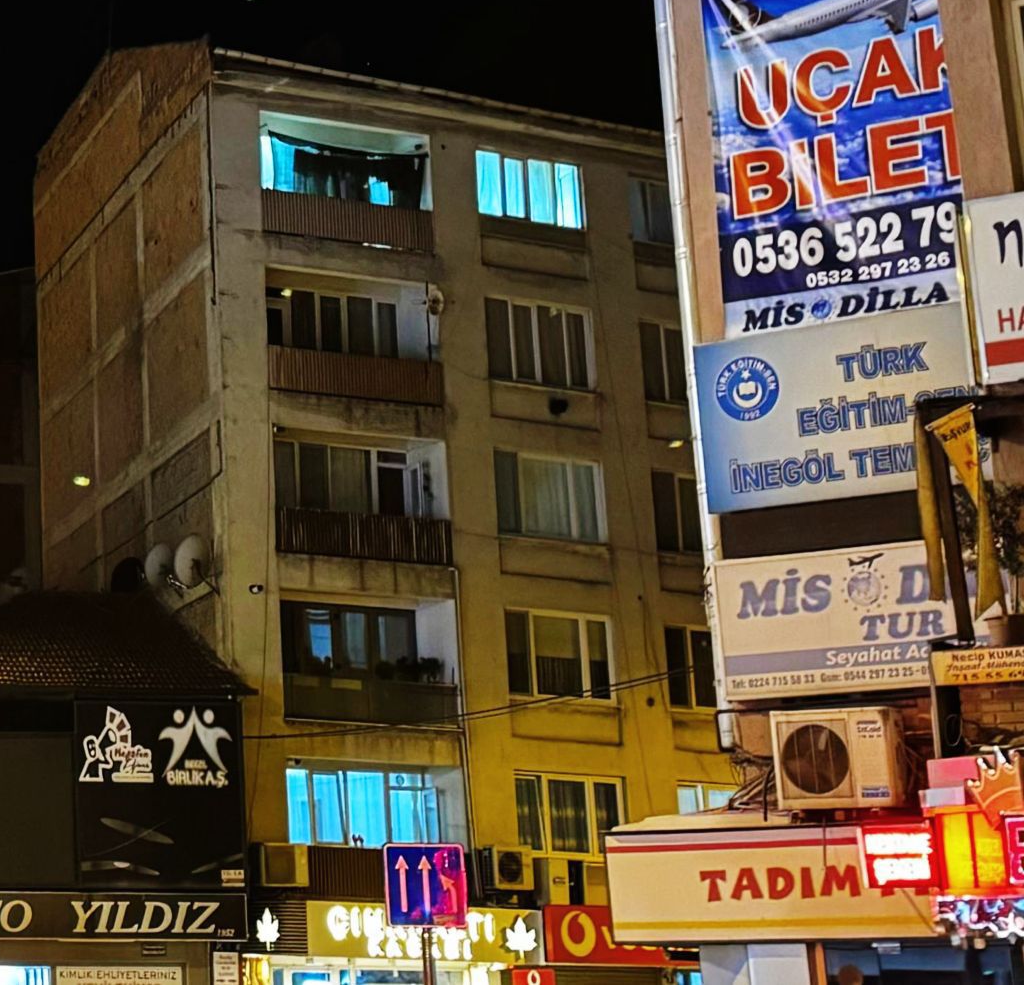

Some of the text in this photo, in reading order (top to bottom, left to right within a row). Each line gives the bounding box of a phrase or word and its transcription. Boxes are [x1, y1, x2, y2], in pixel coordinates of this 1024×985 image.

[733, 202, 956, 277] 0536 522 79
[806, 251, 950, 289] 0532 297 23 26
[742, 282, 950, 333] MİS DİLLA
[836, 341, 928, 382] TÜRK
[730, 449, 846, 495] İNEGÖL
[737, 568, 833, 621] MİS
[860, 608, 946, 642] TUR
[826, 646, 902, 668] Seyahat
[748, 676, 770, 689] 0224
[699, 864, 862, 904] TADIM
[70, 900, 220, 934] YILDIZ
[59, 969, 93, 980] KİMLİK
